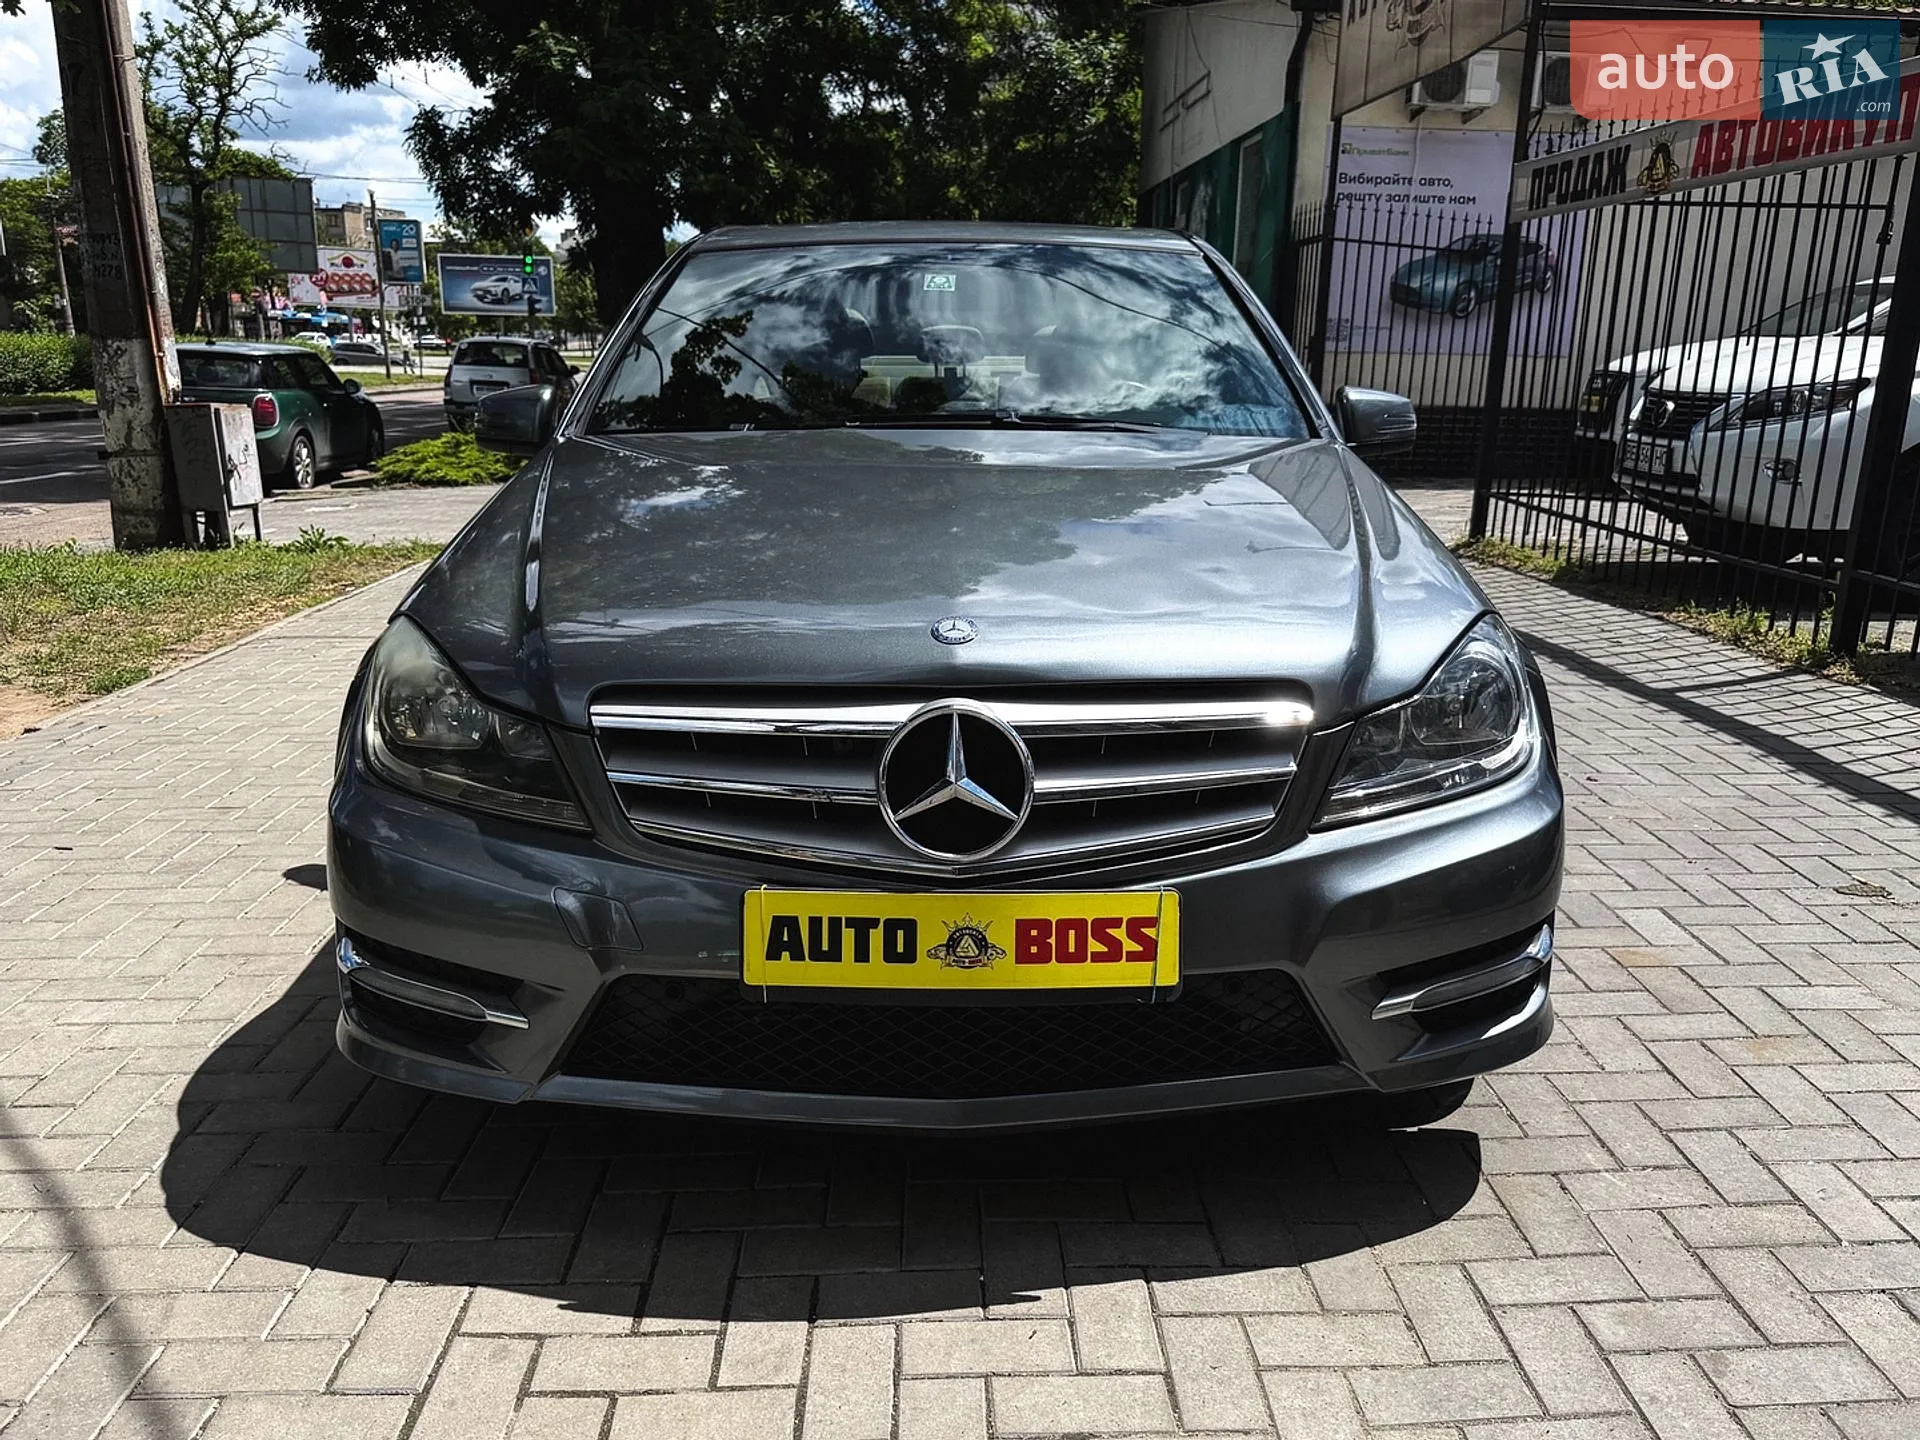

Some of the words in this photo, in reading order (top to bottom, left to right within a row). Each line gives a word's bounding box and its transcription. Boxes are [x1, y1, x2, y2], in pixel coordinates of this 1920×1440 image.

[1528, 143, 1632, 211] ПРОДАЖ
[1690, 73, 1920, 180] АВТОВИКУП
[1336, 192, 1383, 206] решту
[1449, 196, 1476, 205] нам
[1418, 177, 1454, 189] авто,
[765, 914, 918, 964] AUTO
[1014, 916, 1160, 964] BOSS
